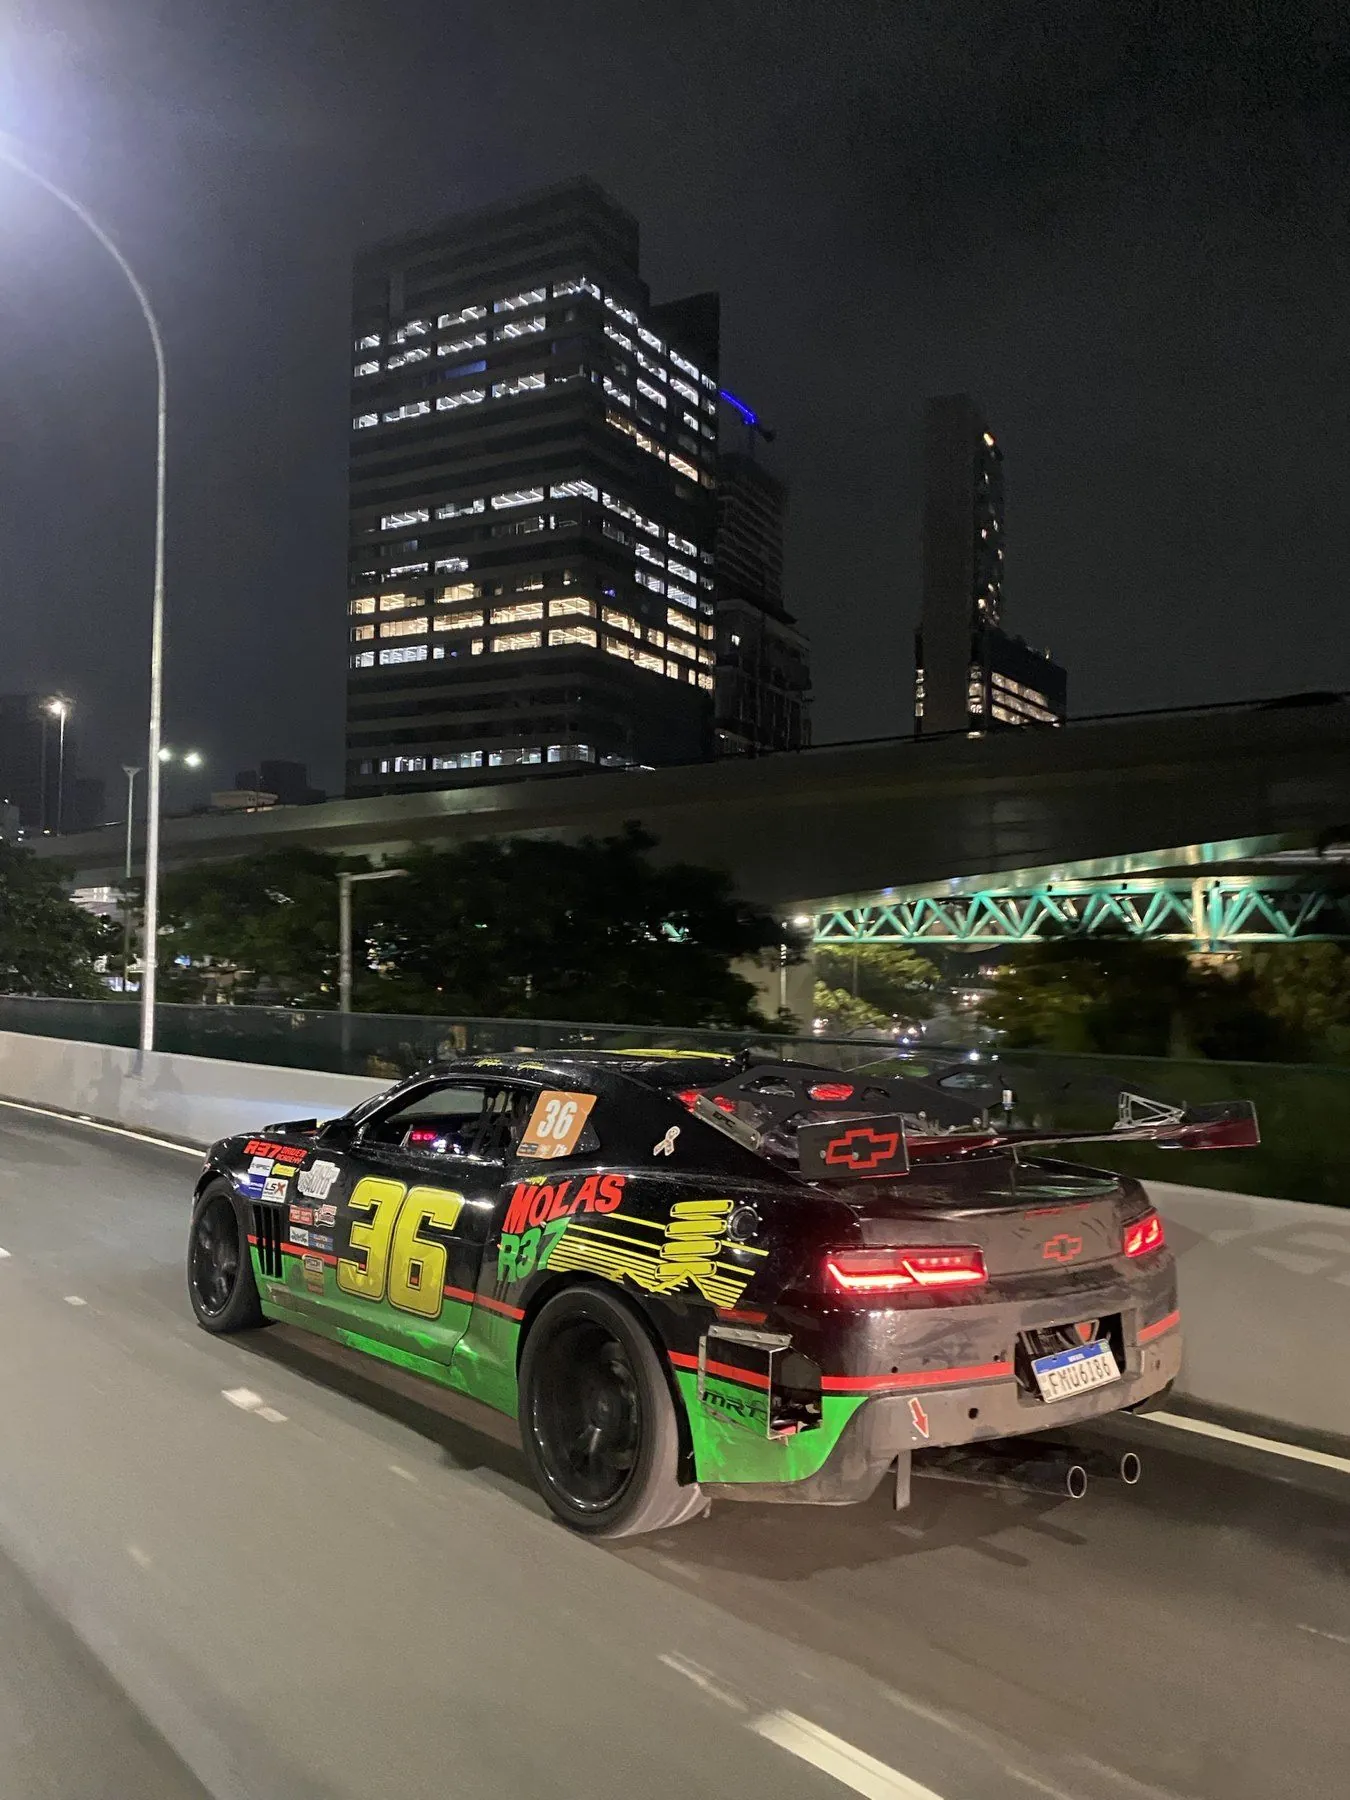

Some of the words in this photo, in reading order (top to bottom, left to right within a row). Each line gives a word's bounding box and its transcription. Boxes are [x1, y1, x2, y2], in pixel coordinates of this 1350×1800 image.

[536, 1099, 578, 1139] 36
[243, 1139, 283, 1158] R37
[265, 1182, 286, 1196] LSX
[501, 1174, 625, 1234] MOLAS
[336, 1176, 466, 1319] 36
[497, 1216, 571, 1283] R37
